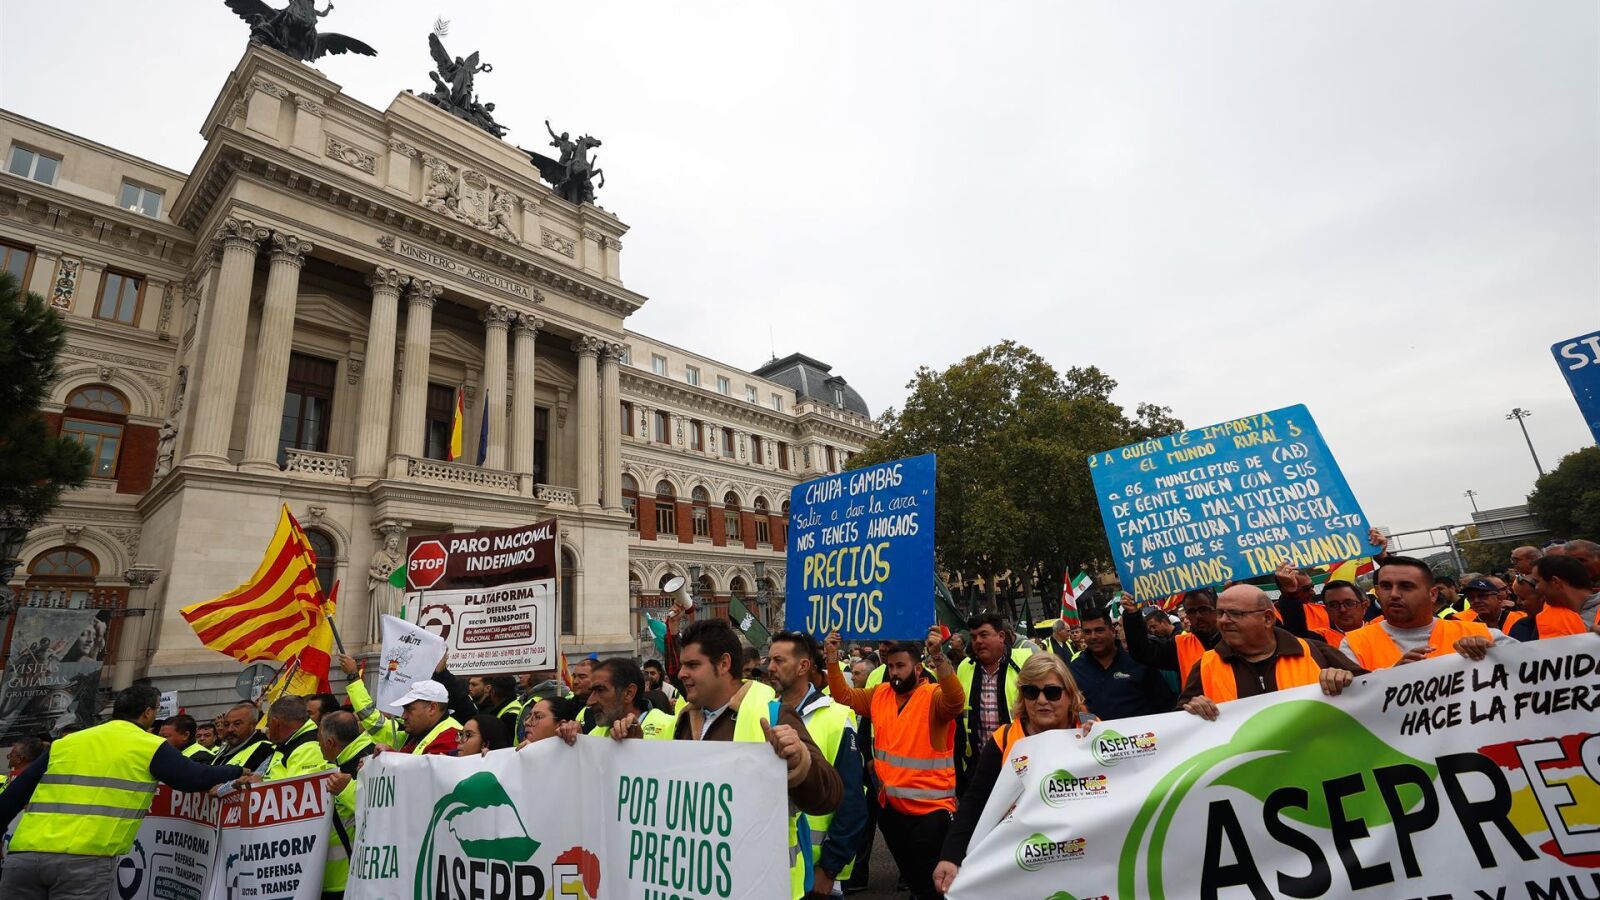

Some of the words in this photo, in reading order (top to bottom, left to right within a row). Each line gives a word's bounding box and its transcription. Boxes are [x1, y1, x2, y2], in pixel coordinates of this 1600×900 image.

[400, 243, 456, 270] MINISTERIO
[466, 268, 529, 297] AGRICULTURA
[1105, 453, 1114, 466] A
[1201, 413, 1274, 440] IMPORTA
[1140, 458, 1158, 472] EL
[1166, 443, 1216, 465] MUNDO
[1233, 428, 1283, 449] RURAL
[1125, 481, 1143, 497] 86
[1155, 460, 1239, 489] MUNICIPIOS
[1245, 455, 1263, 469] DE
[1271, 441, 1308, 464] (AB)
[845, 499, 865, 519] dar
[868, 495, 884, 513] la
[1112, 502, 1130, 519] DE
[1135, 489, 1180, 513] GENTE
[1184, 477, 1233, 500] JOVEN
[1240, 469, 1272, 489] CON
[1283, 460, 1317, 480] SUS
[1117, 507, 1191, 538] FAMILIAS
[1201, 478, 1320, 518] MAL-VIVIENDO
[450, 537, 490, 554] PARO
[494, 525, 554, 550] NACIONAL
[797, 532, 815, 552] NOS
[821, 521, 859, 545] TENEIS
[866, 512, 919, 540] AHOGAOS
[1121, 540, 1136, 558] DE
[1142, 517, 1231, 554] AGRICULTURA
[1229, 514, 1240, 532] Y
[1247, 496, 1340, 529] GANADERIA
[1125, 560, 1134, 574] Y
[1140, 556, 1155, 570] DE
[1163, 550, 1177, 565] LO
[1184, 542, 1206, 558] QUE
[1209, 538, 1224, 552] SE
[1237, 526, 1291, 548] GENERA
[1297, 522, 1315, 535] DE
[1324, 513, 1361, 530] ESTO
[410, 558, 444, 571] STOP
[466, 547, 535, 571] INDEFINIDO
[803, 541, 891, 591] PRECIOS
[1134, 555, 1233, 602] ARRUINADOS
[1240, 532, 1362, 575] TRABAJANDO
[464, 588, 534, 606] PLATAFORMA
[486, 604, 517, 614] DEFENSA
[805, 589, 883, 635] JUSTOS
[489, 612, 530, 624] TRANSPORTE
[494, 632, 530, 640] INTERNACIONAL
[8, 676, 69, 688] GUIADAS
[12, 663, 60, 674] VISITAS
[1382, 669, 1465, 713] PORQUE
[1472, 663, 1509, 693] LA
[1519, 653, 1600, 685] UNID
[6, 690, 48, 698] GRATUITAS
[1400, 705, 1462, 736] HACE
[1469, 695, 1507, 724] LA
[170, 789, 218, 825] PARAR
[617, 775, 659, 827] POR
[666, 779, 733, 837] UNOS
[155, 829, 209, 856] PLATAFORMA
[174, 852, 194, 868] DEFENSA
[1025, 856, 1055, 864] ALBACETE
[257, 862, 303, 879] DEFENSA
[628, 829, 732, 898] PRECIOS
